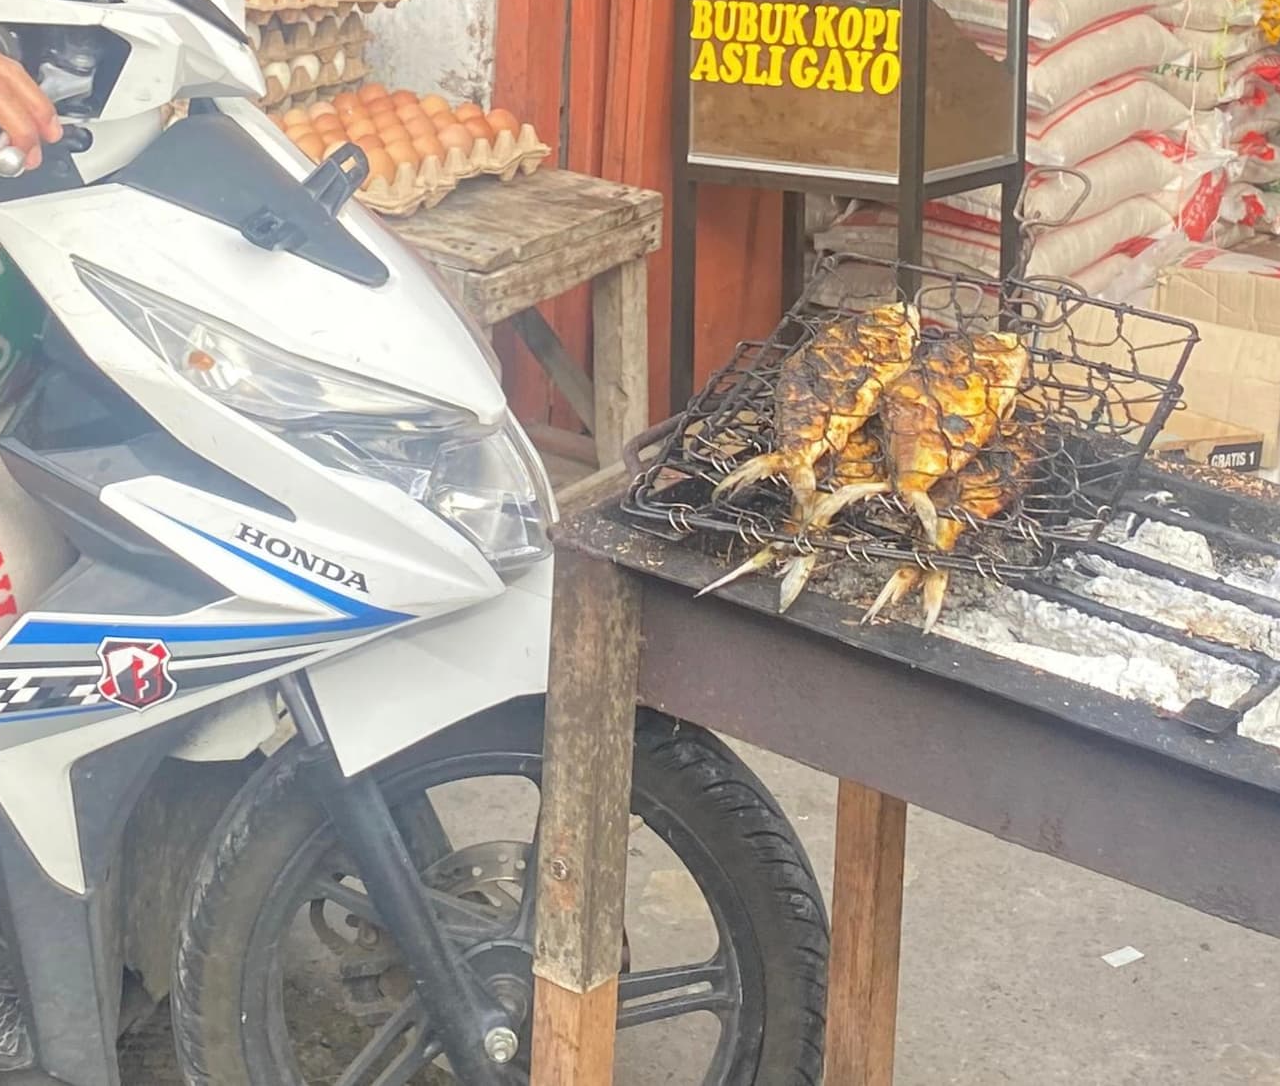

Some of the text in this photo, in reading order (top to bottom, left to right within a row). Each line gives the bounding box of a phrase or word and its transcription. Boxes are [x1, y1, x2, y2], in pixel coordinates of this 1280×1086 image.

[812, 5, 902, 52] KOPI
[689, 40, 902, 95] ASLI GAYO
[1210, 452, 1247, 468] GRATIS
[234, 522, 370, 594] HONDA
